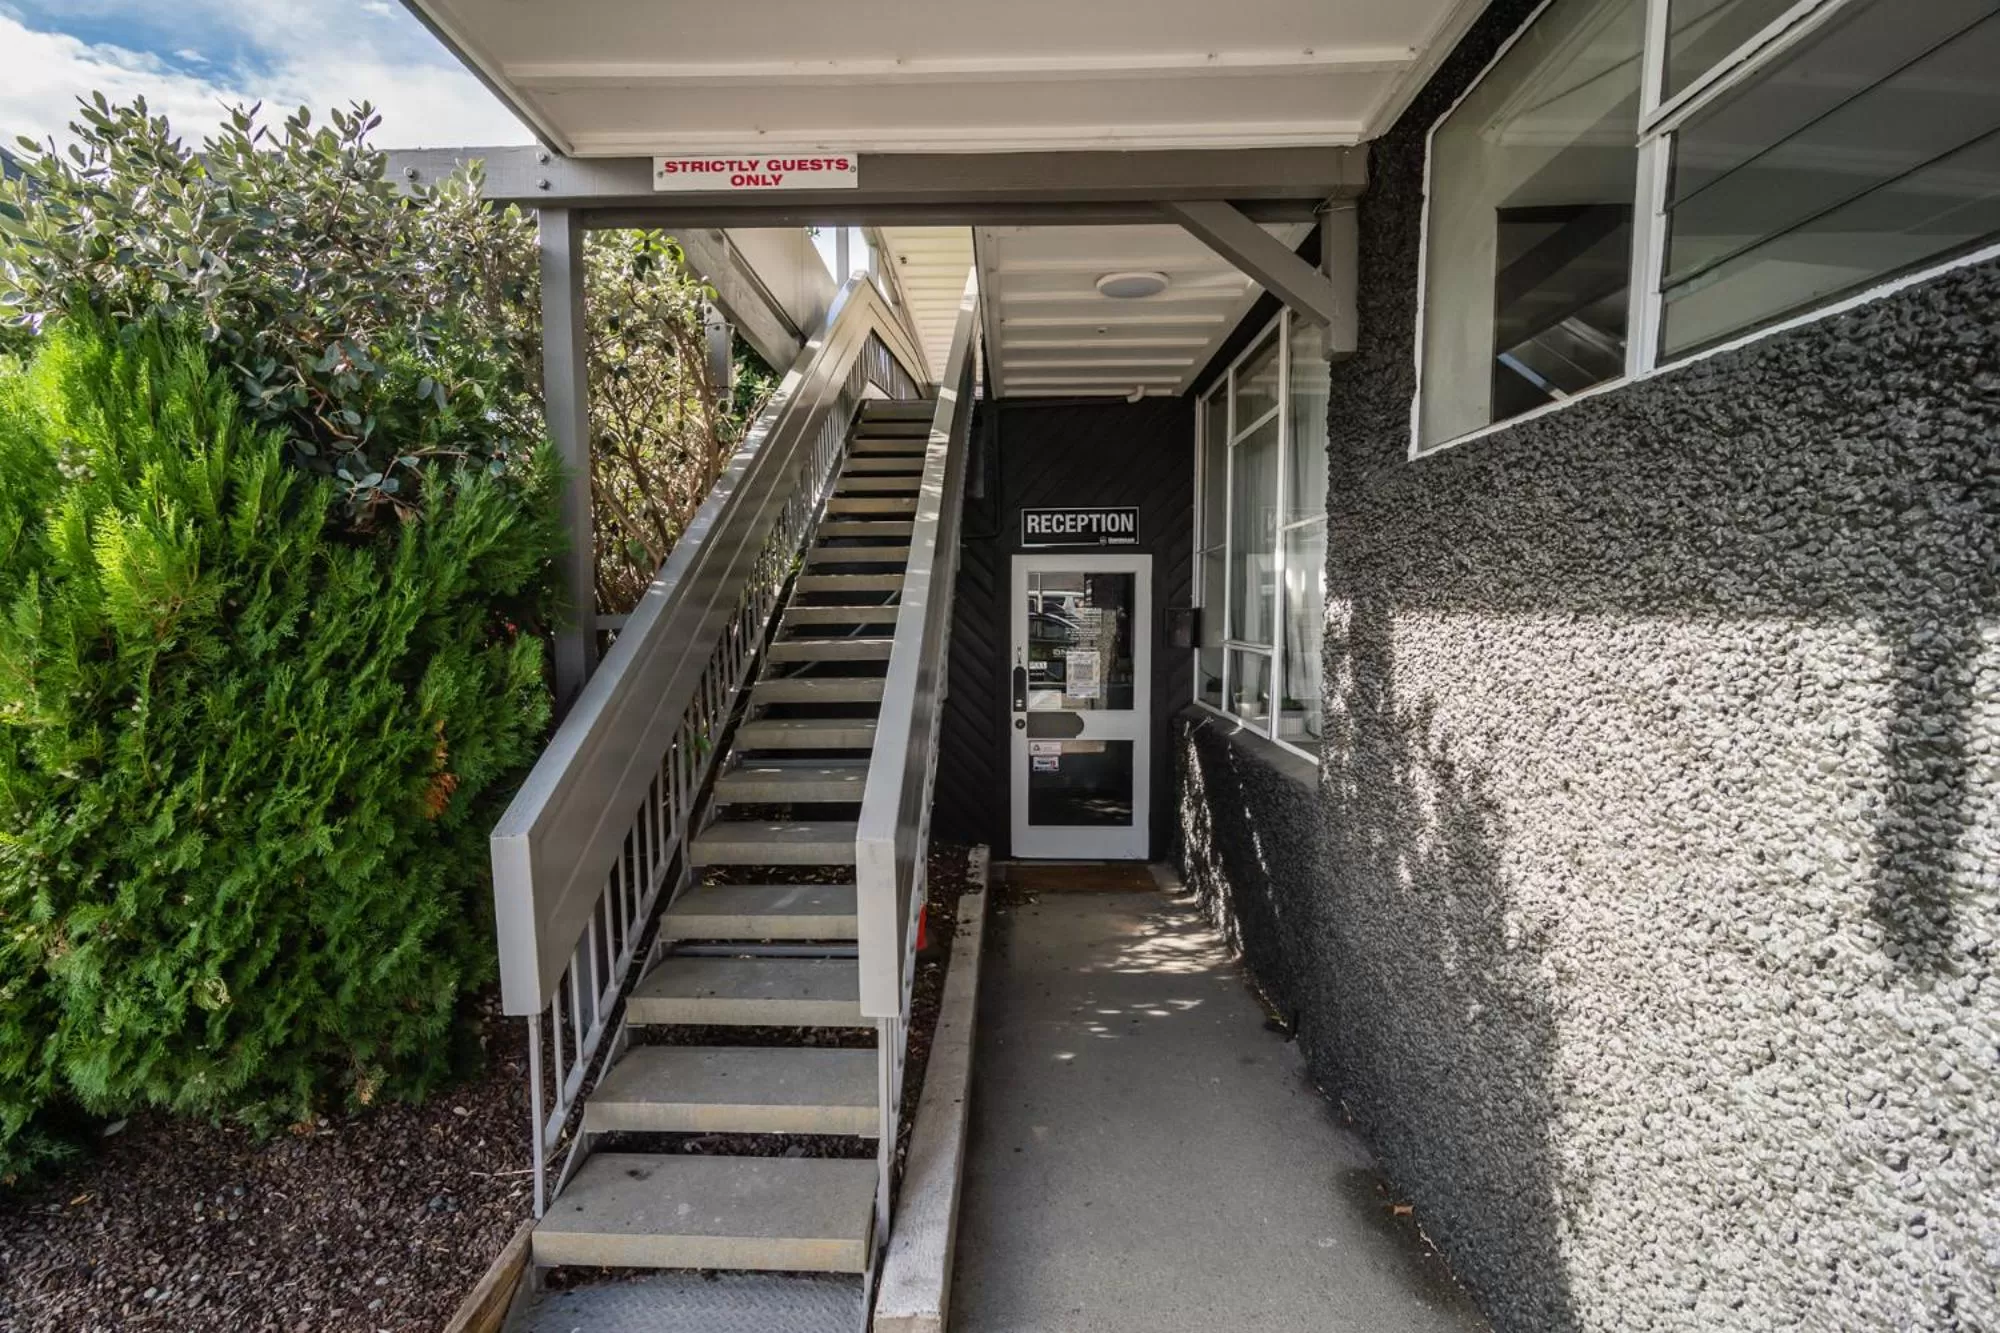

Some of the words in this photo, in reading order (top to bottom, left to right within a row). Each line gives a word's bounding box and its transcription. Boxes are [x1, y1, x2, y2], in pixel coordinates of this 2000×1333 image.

[664, 160, 760, 173] STRICTLY
[766, 158, 849, 171] GUESTS
[730, 174, 783, 187] ONLY
[1027, 513, 1134, 534] RECEPTION
